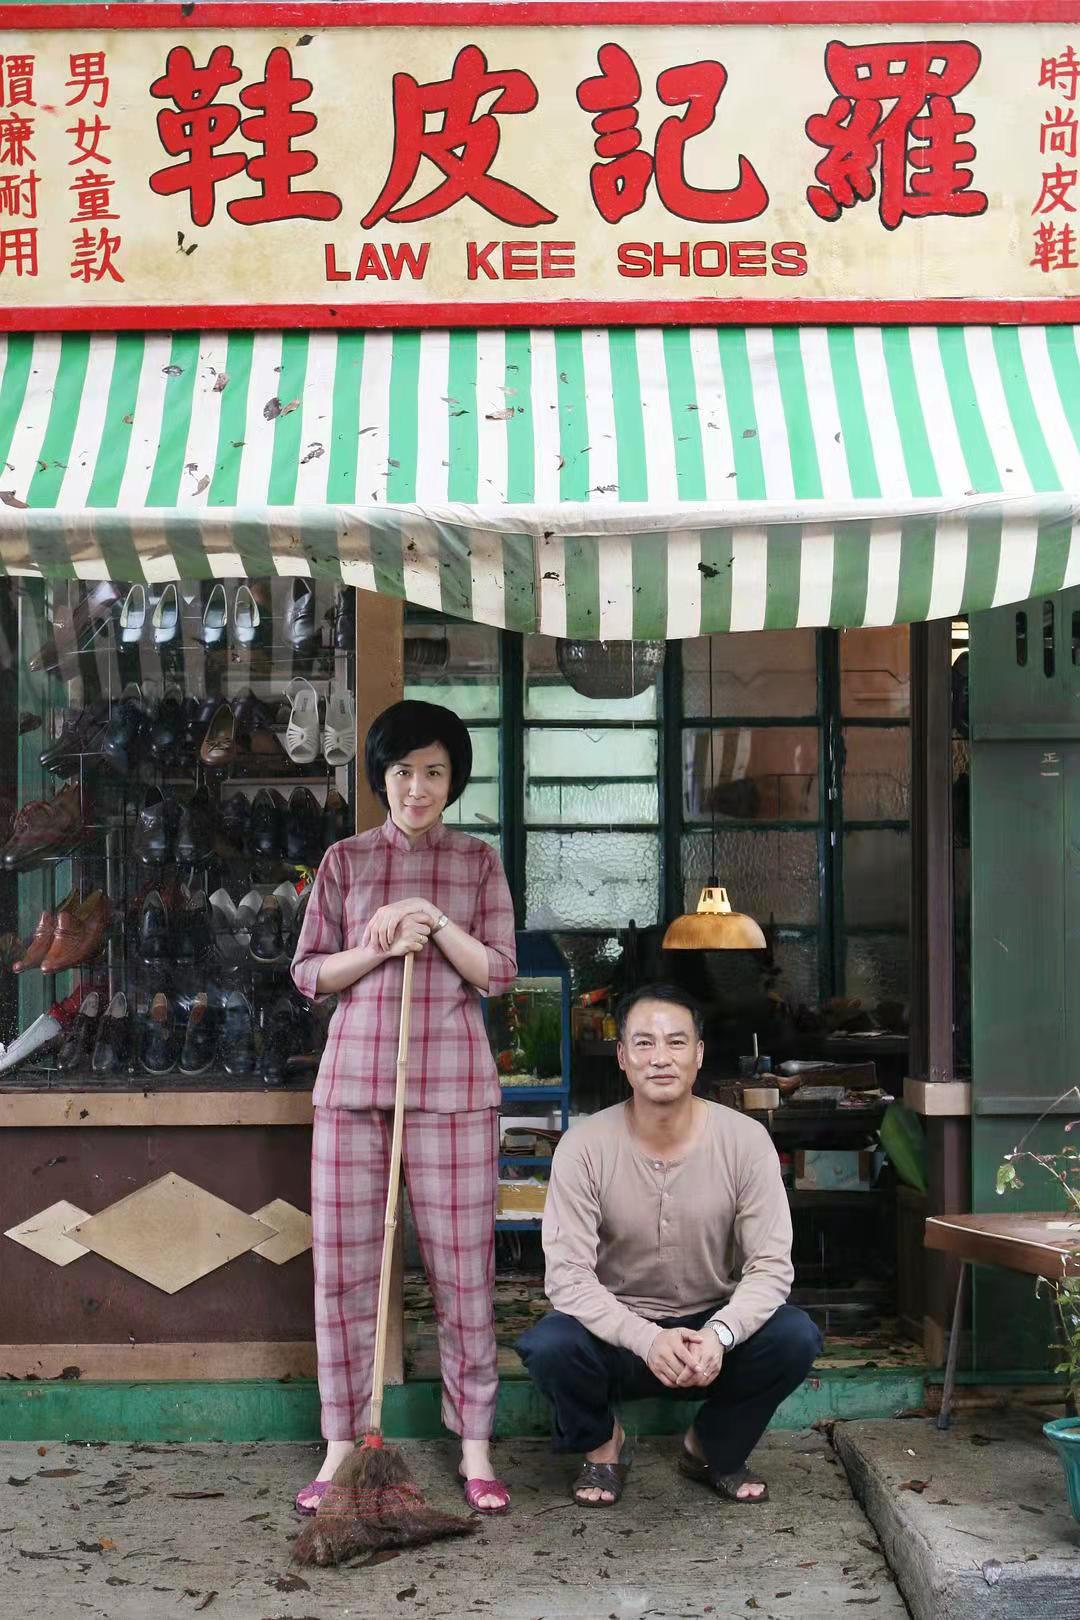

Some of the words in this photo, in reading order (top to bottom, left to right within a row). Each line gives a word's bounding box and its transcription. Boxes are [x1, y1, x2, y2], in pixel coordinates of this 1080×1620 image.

[0, 54, 42, 277] 價廉耐用
[65, 51, 125, 283] 男女童款
[149, 40, 988, 231] 羅記皮鞋
[1029, 45, 1080, 273] 時尚皮鞋
[325, 243, 430, 281] LAW
[467, 241, 575, 280] KEE
[618, 241, 807, 278] SHOES
